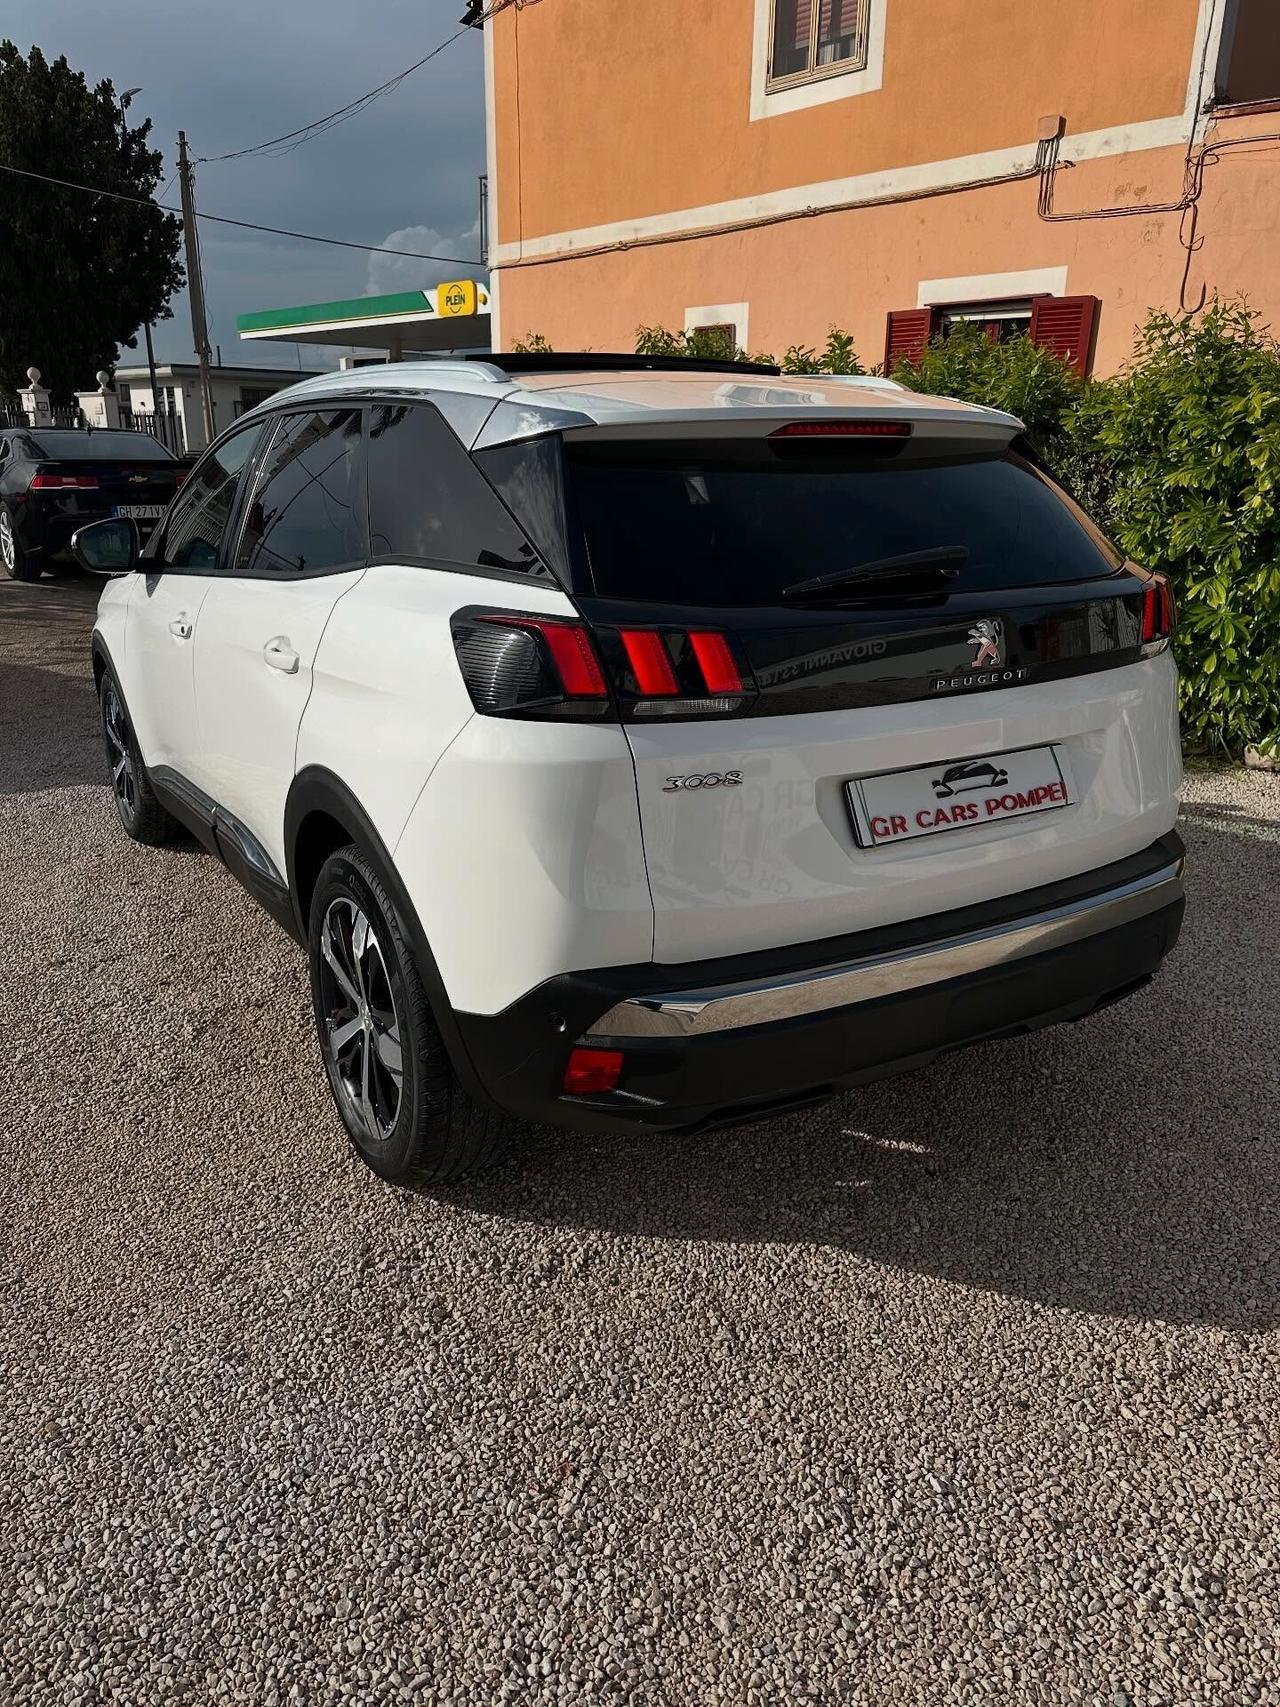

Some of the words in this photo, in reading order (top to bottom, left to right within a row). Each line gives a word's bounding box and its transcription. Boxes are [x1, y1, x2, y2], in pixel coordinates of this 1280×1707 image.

[445, 291, 466, 306] PLEIN
[936, 669, 1024, 690] PEUGEOT
[662, 770, 744, 793] 3008
[869, 815, 908, 838] GR
[916, 803, 979, 829] CARS
[984, 780, 1068, 816] POMPEI
